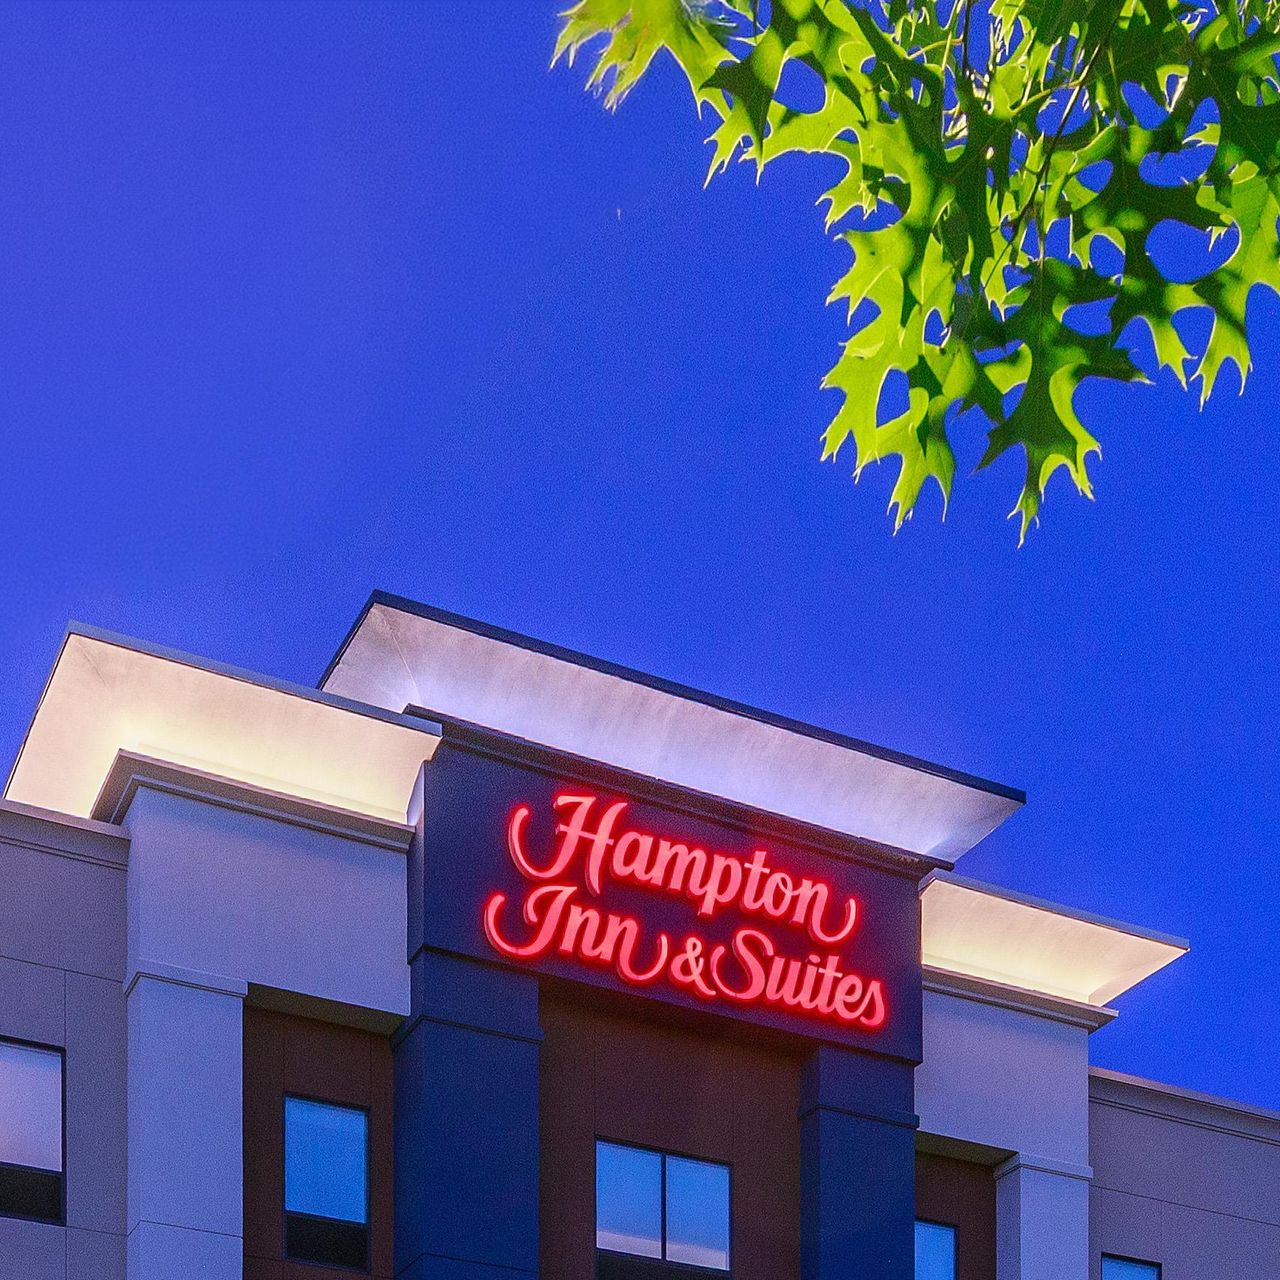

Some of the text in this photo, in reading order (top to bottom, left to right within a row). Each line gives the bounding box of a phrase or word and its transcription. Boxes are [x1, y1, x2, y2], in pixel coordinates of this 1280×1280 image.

[508, 795, 857, 944] Hampton
[483, 885, 886, 1028] Inn & Suites
